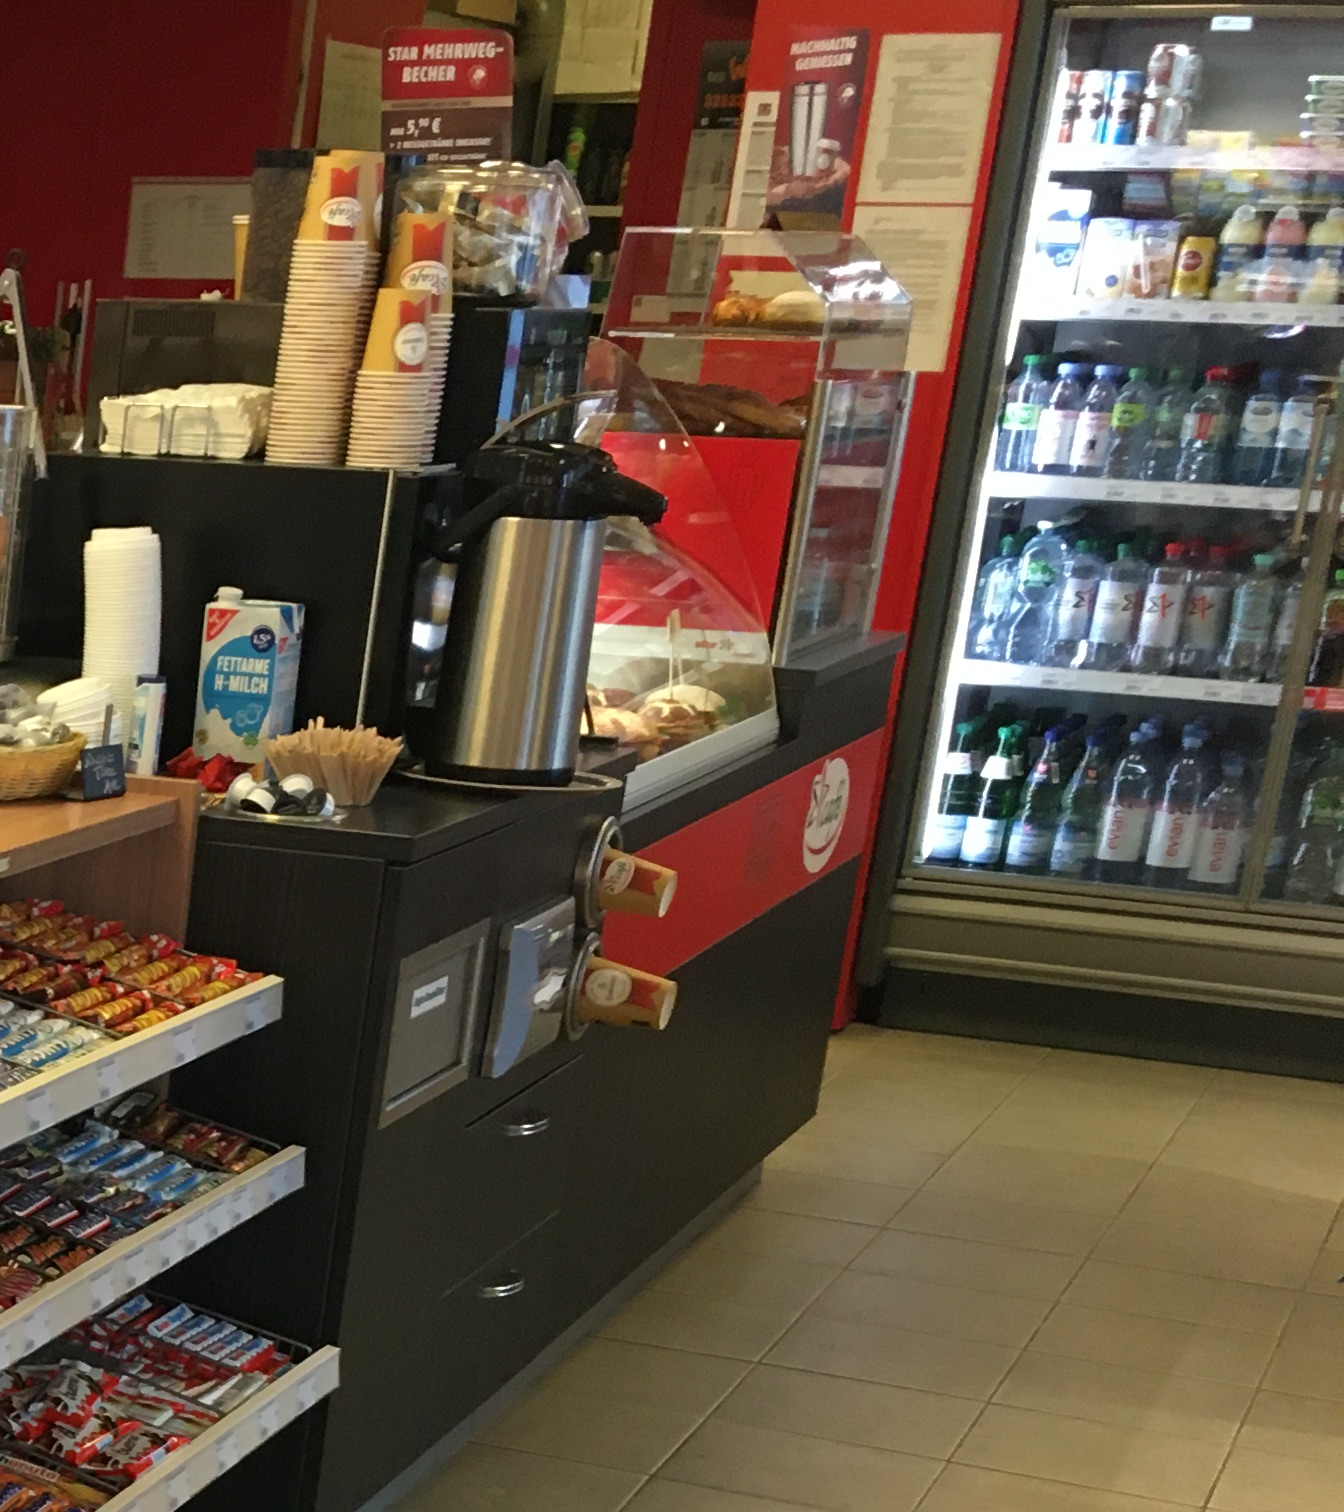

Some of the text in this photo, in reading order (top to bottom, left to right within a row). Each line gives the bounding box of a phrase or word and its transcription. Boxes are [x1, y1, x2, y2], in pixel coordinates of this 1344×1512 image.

[387, 41, 504, 61] STAR MEHRWEG-
[402, 65, 456, 83] BECHER
[216, 655, 271, 675] FETTARME
[213, 673, 269, 695] H-MILCH
[1107, 809, 1126, 851] evian
[1165, 815, 1185, 858] evian
[1209, 830, 1229, 873] evian
